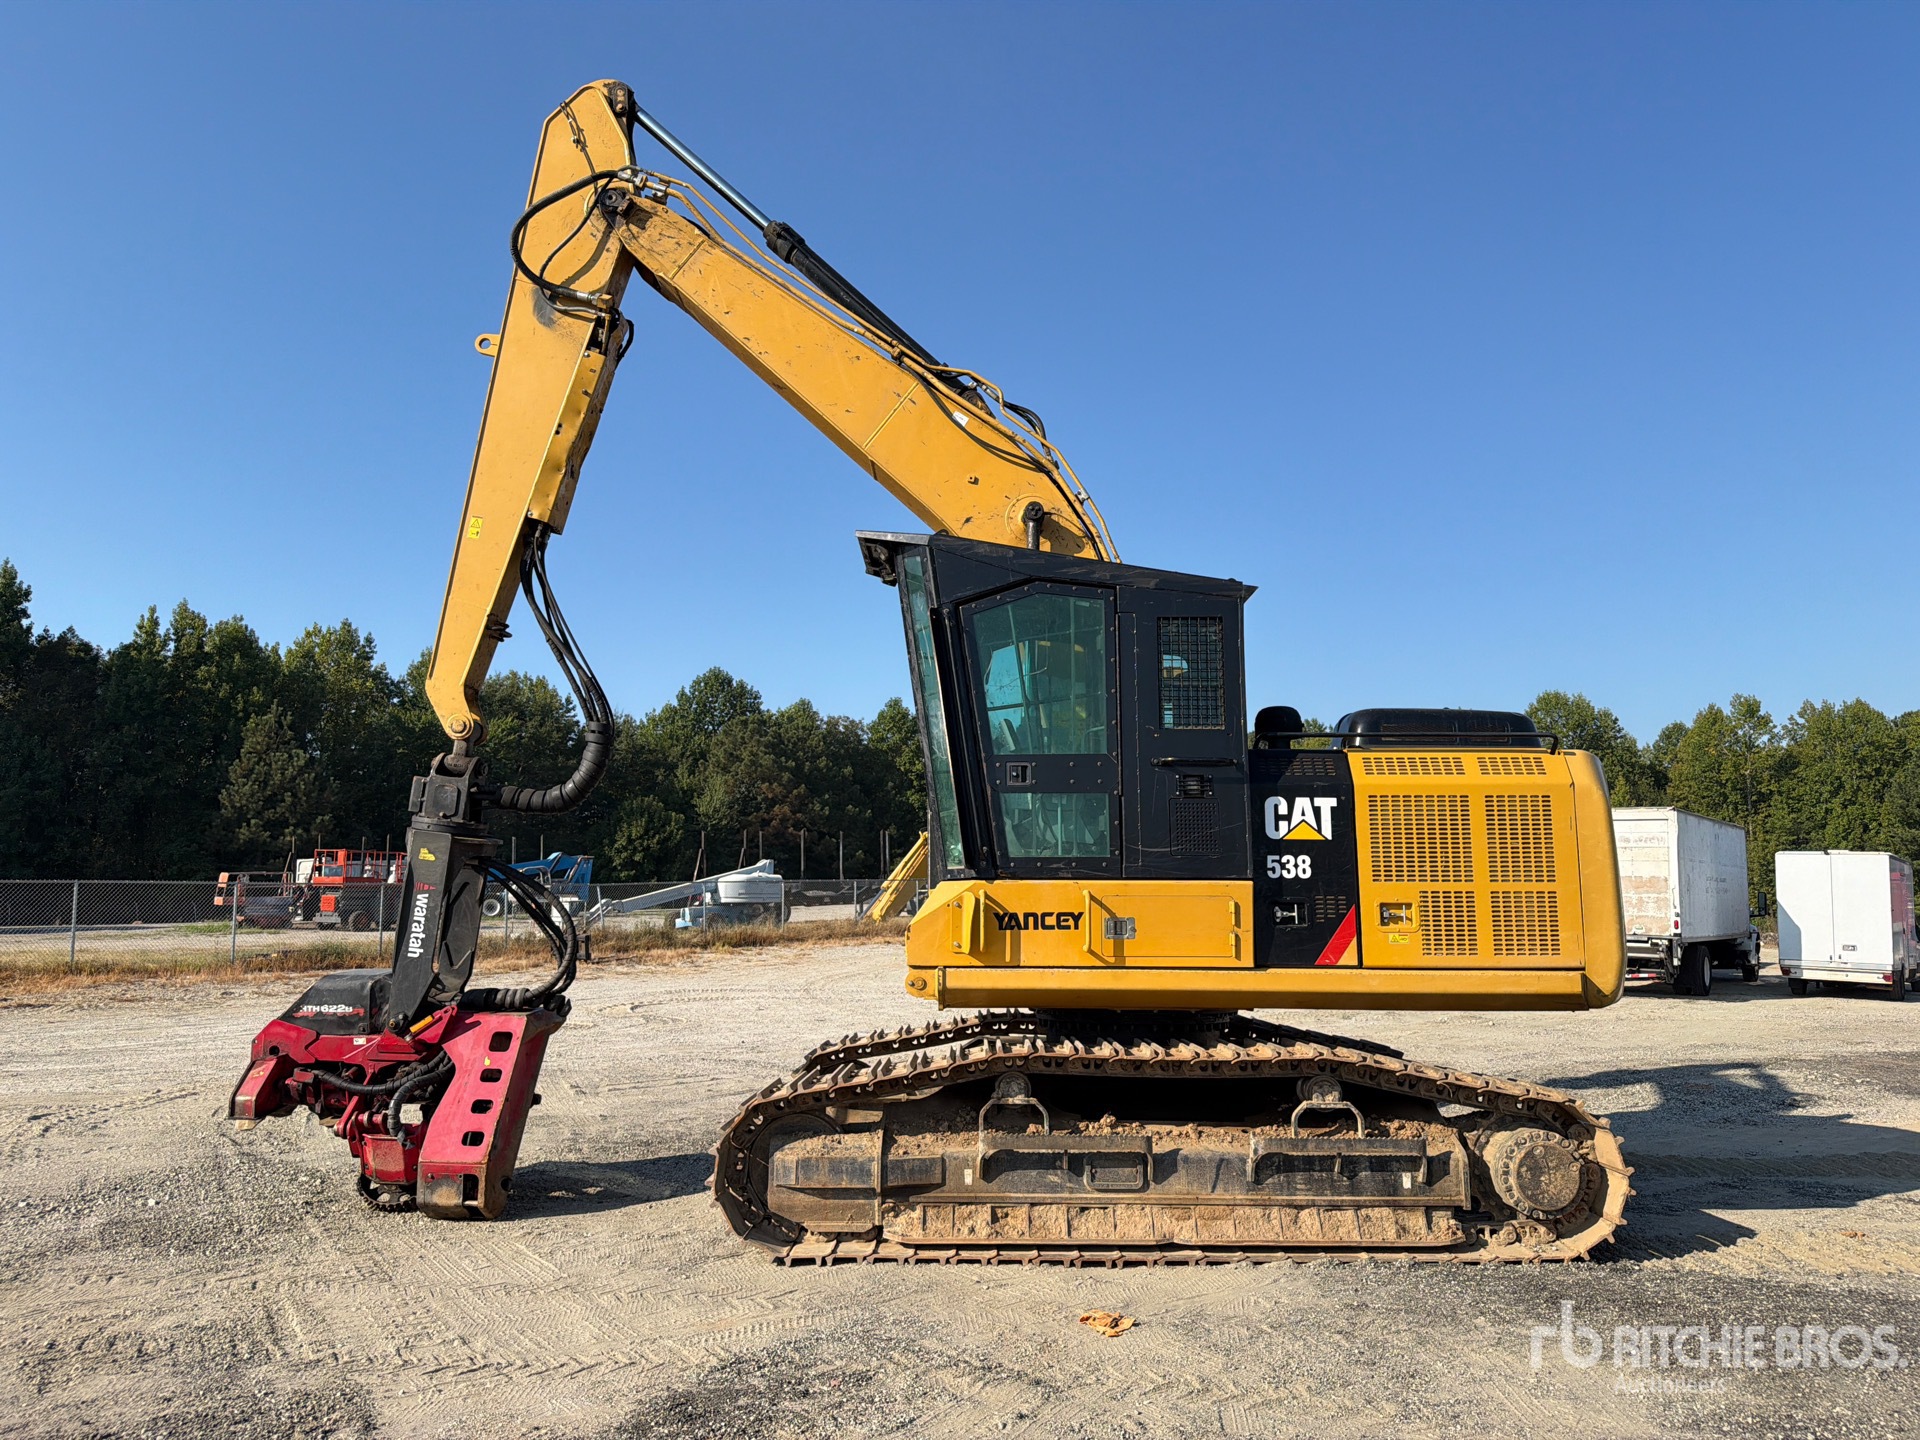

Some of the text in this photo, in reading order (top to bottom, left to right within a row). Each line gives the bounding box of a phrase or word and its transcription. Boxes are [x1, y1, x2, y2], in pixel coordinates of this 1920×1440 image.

[1264, 796, 1337, 840] CAT
[1266, 854, 1312, 879] 538
[407, 893, 429, 957] waratah
[993, 911, 1085, 930] YANCEY
